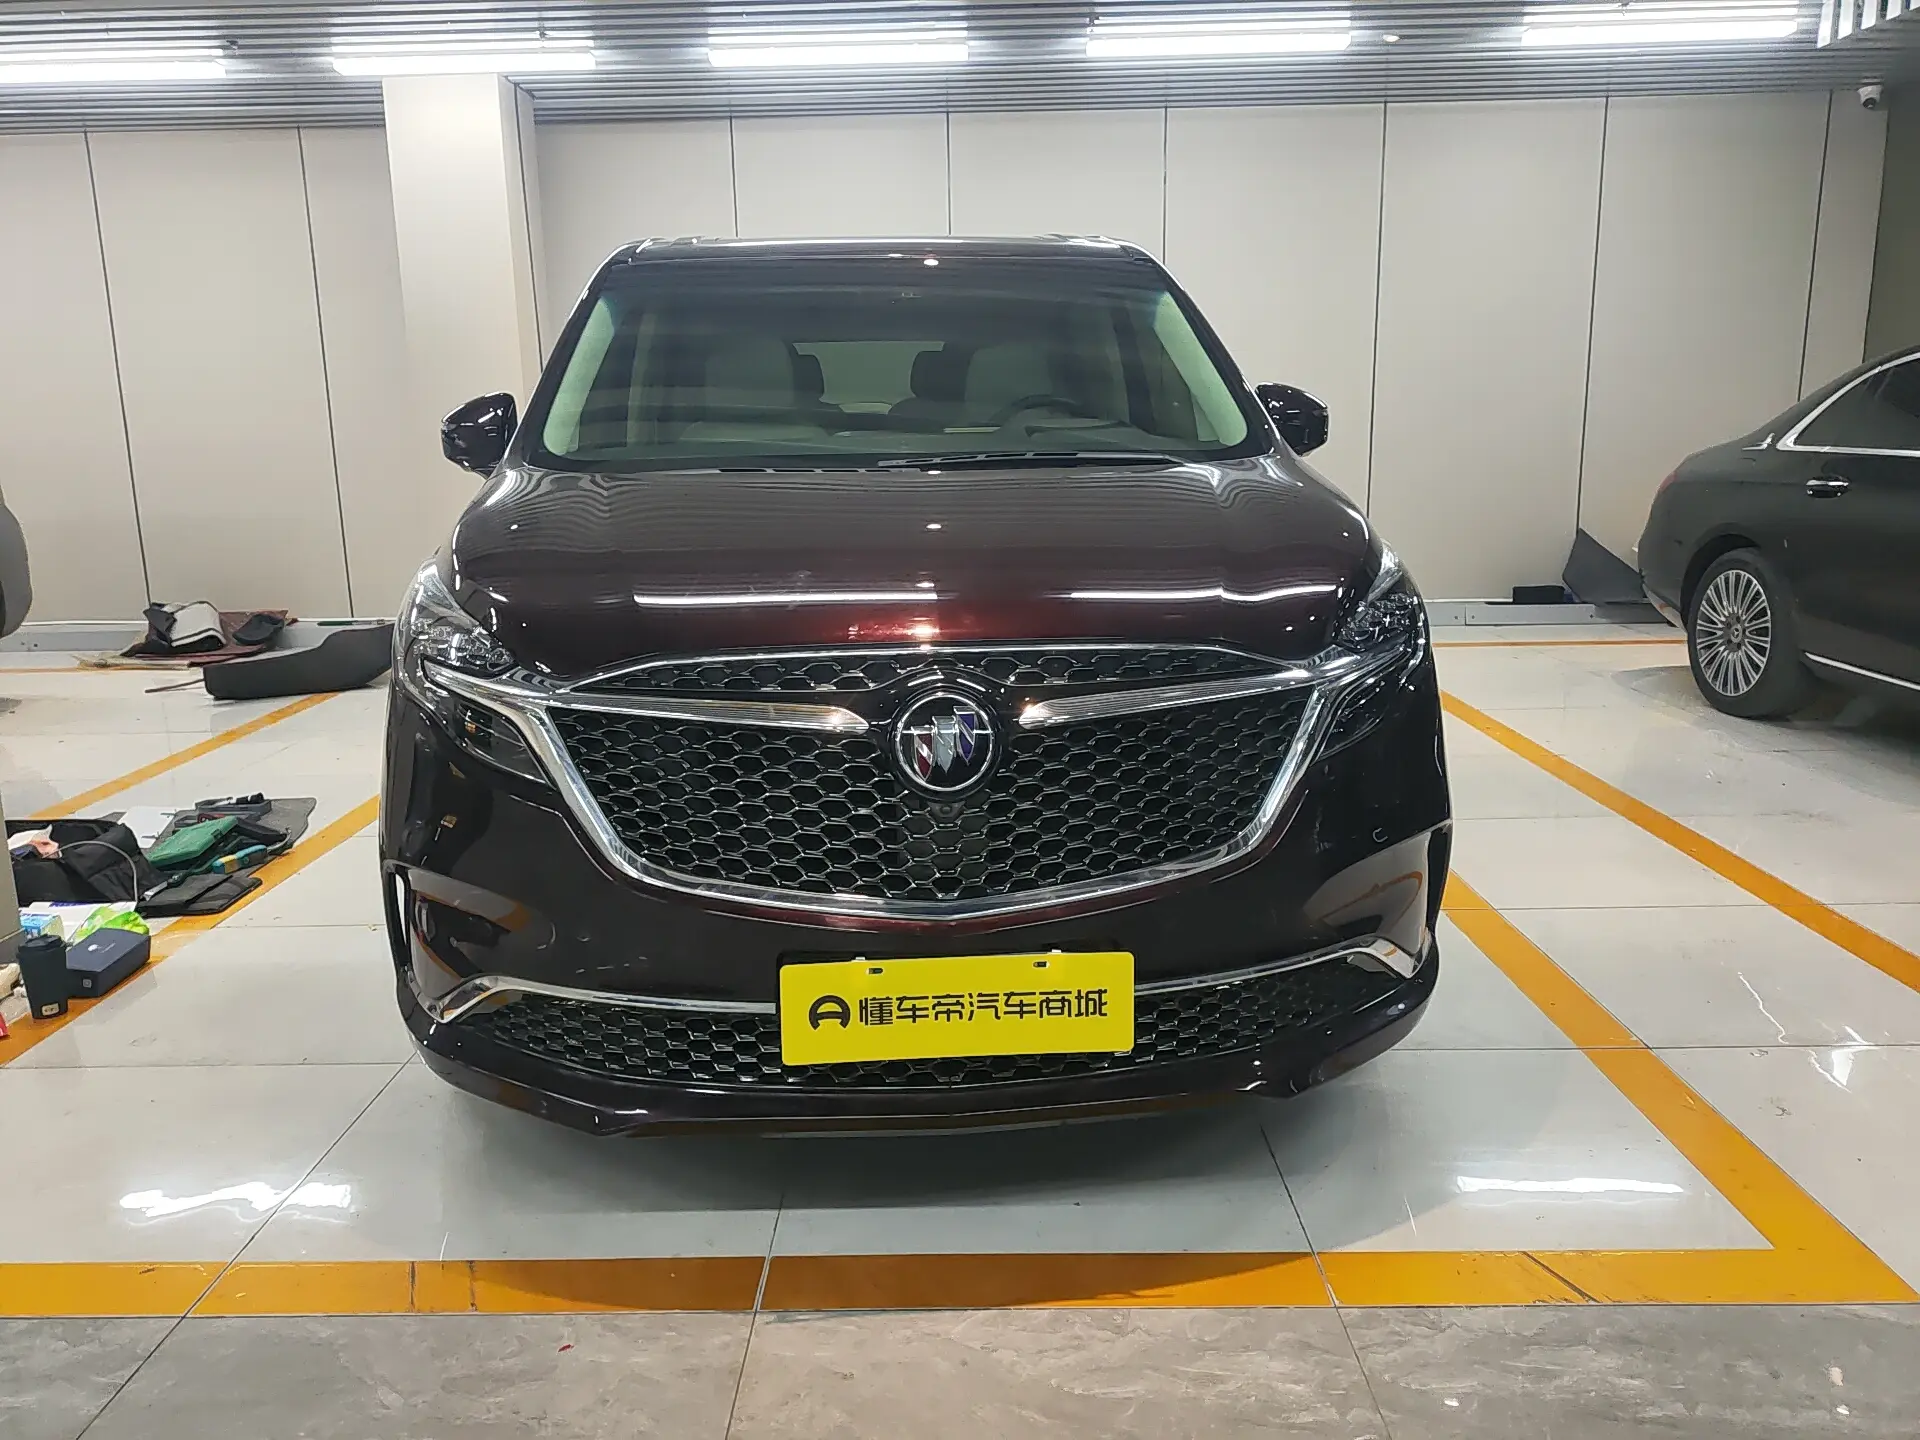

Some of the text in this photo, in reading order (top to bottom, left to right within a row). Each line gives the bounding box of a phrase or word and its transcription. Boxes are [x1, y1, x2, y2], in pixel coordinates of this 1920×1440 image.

[859, 988, 1108, 1026] 懂车帝汽车商城
